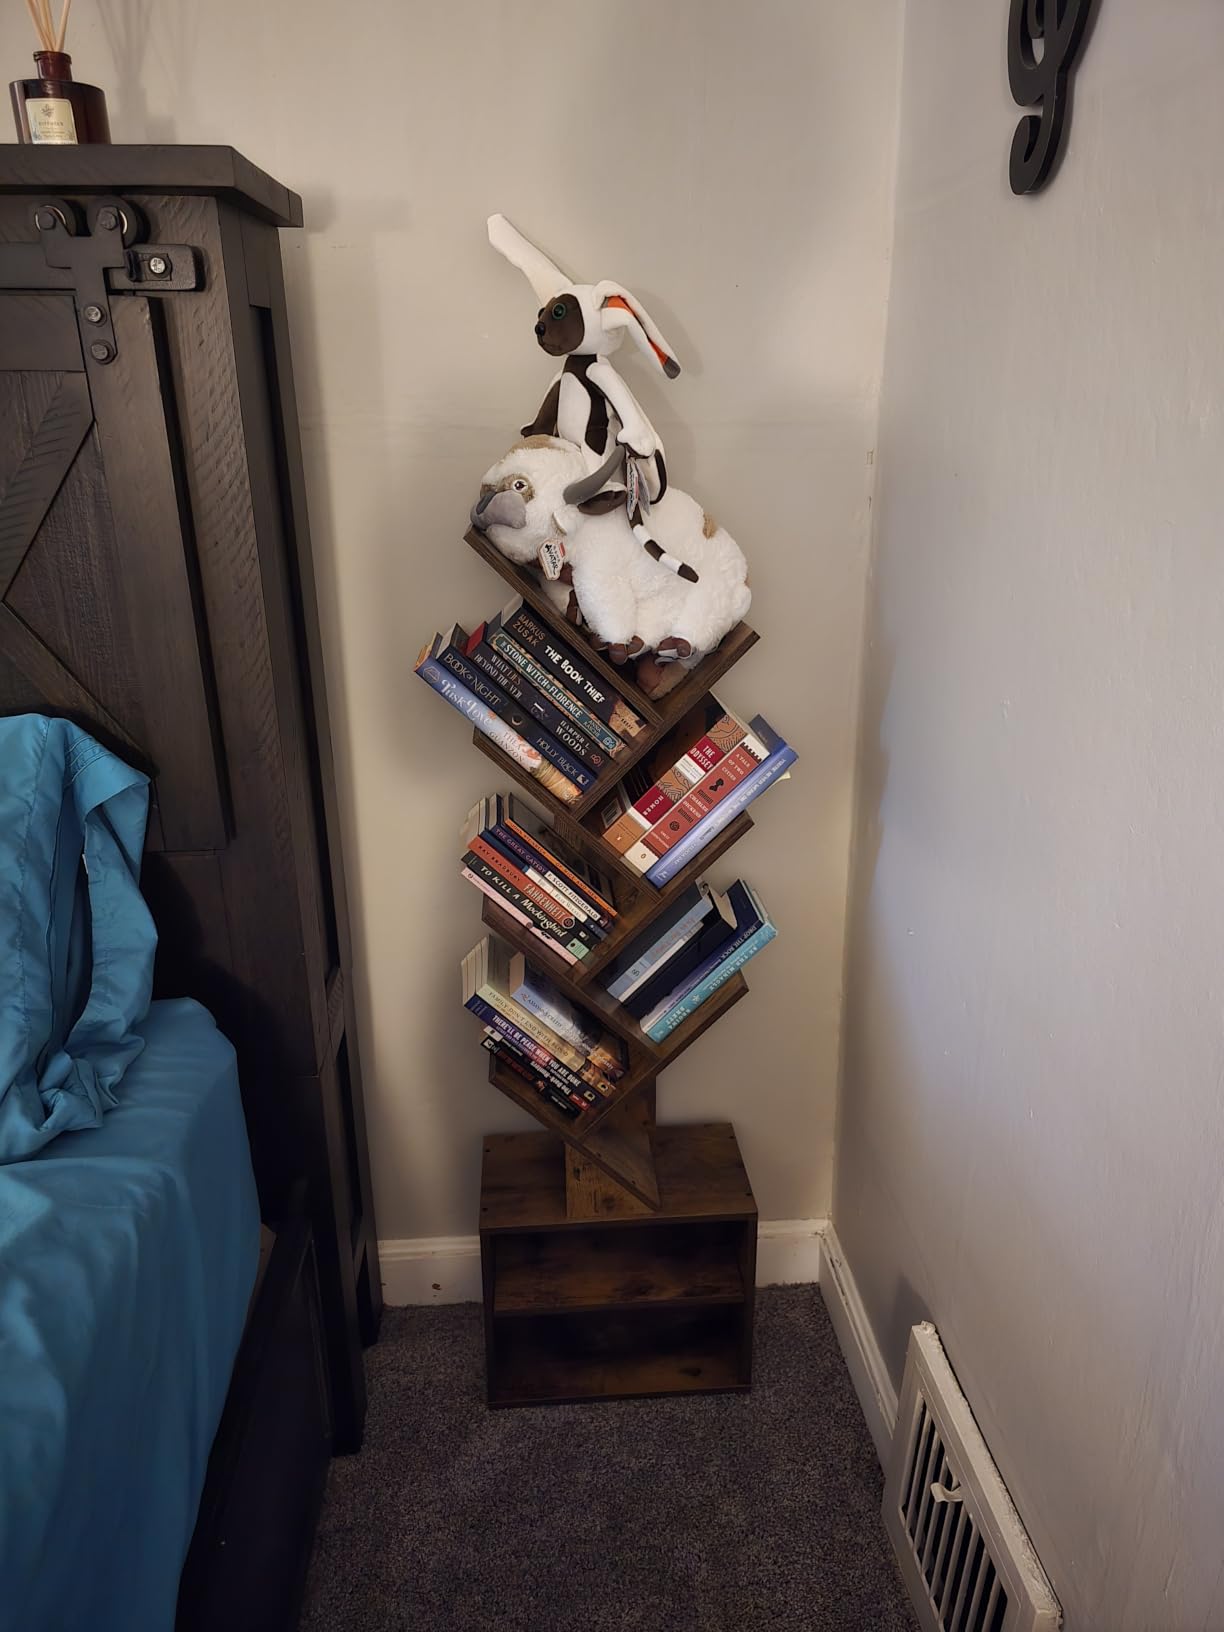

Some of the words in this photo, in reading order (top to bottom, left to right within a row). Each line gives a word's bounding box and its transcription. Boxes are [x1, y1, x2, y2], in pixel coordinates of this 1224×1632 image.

[510, 619, 540, 648] ZUSAK
[516, 612, 547, 641] MARKUS
[442, 652, 471, 679] BOOK
[467, 675, 503, 708] NIGHT
[472, 653, 499, 678] BEYOND
[495, 673, 511, 689] THE
[488, 654, 510, 674] WHAT
[541, 644, 563, 665] THE
[558, 658, 586, 685] BOOK
[580, 679, 607, 706] THIEF
[435, 675, 472, 710] Tusk
[502, 643, 528, 668] STONE
[523, 662, 550, 687] WITCH
[547, 684, 583, 719] FLORENCE
[552, 724, 588, 757] WOODS
[558, 719, 586, 744] HARPER
[586, 718, 602, 733] ANNA
[487, 729, 524, 763] GUANZON
[534, 736, 559, 759] HOLLY
[554, 754, 579, 777] BLACK
[701, 744, 716, 759] THE
[640, 794, 665, 816] HOMER
[682, 798, 702, 820] DICKENS
[687, 791, 709, 814] CHARLES
[477, 844, 491, 857] RAY
[489, 855, 522, 883] BRADBURY
[493, 827, 507, 840] THE
[505, 837, 526, 856] GREAT
[523, 853, 547, 874] GATSBY
[479, 864, 493, 878] TO
[490, 874, 513, 894] KILL
[511, 891, 521, 901] A
[516, 896, 568, 942] Mockingbird
[521, 881, 567, 922] FAHRENHEIT
[550, 876, 570, 894] SCOTT
[565, 890, 600, 920] FITZGERALD
[718, 944, 735, 960] ROCK
[731, 936, 744, 948] THE
[487, 990, 509, 1009] FAMILY
[491, 1013, 515, 1035] THERE'LL
[512, 1030, 523, 1041] BE
[518, 1035, 538, 1053] PEACE
[533, 1047, 552, 1064] WHEN
[547, 1058, 560, 1071] YOU
[555, 1064, 570, 1078] ARE
[565, 1072, 582, 1087] DONE
